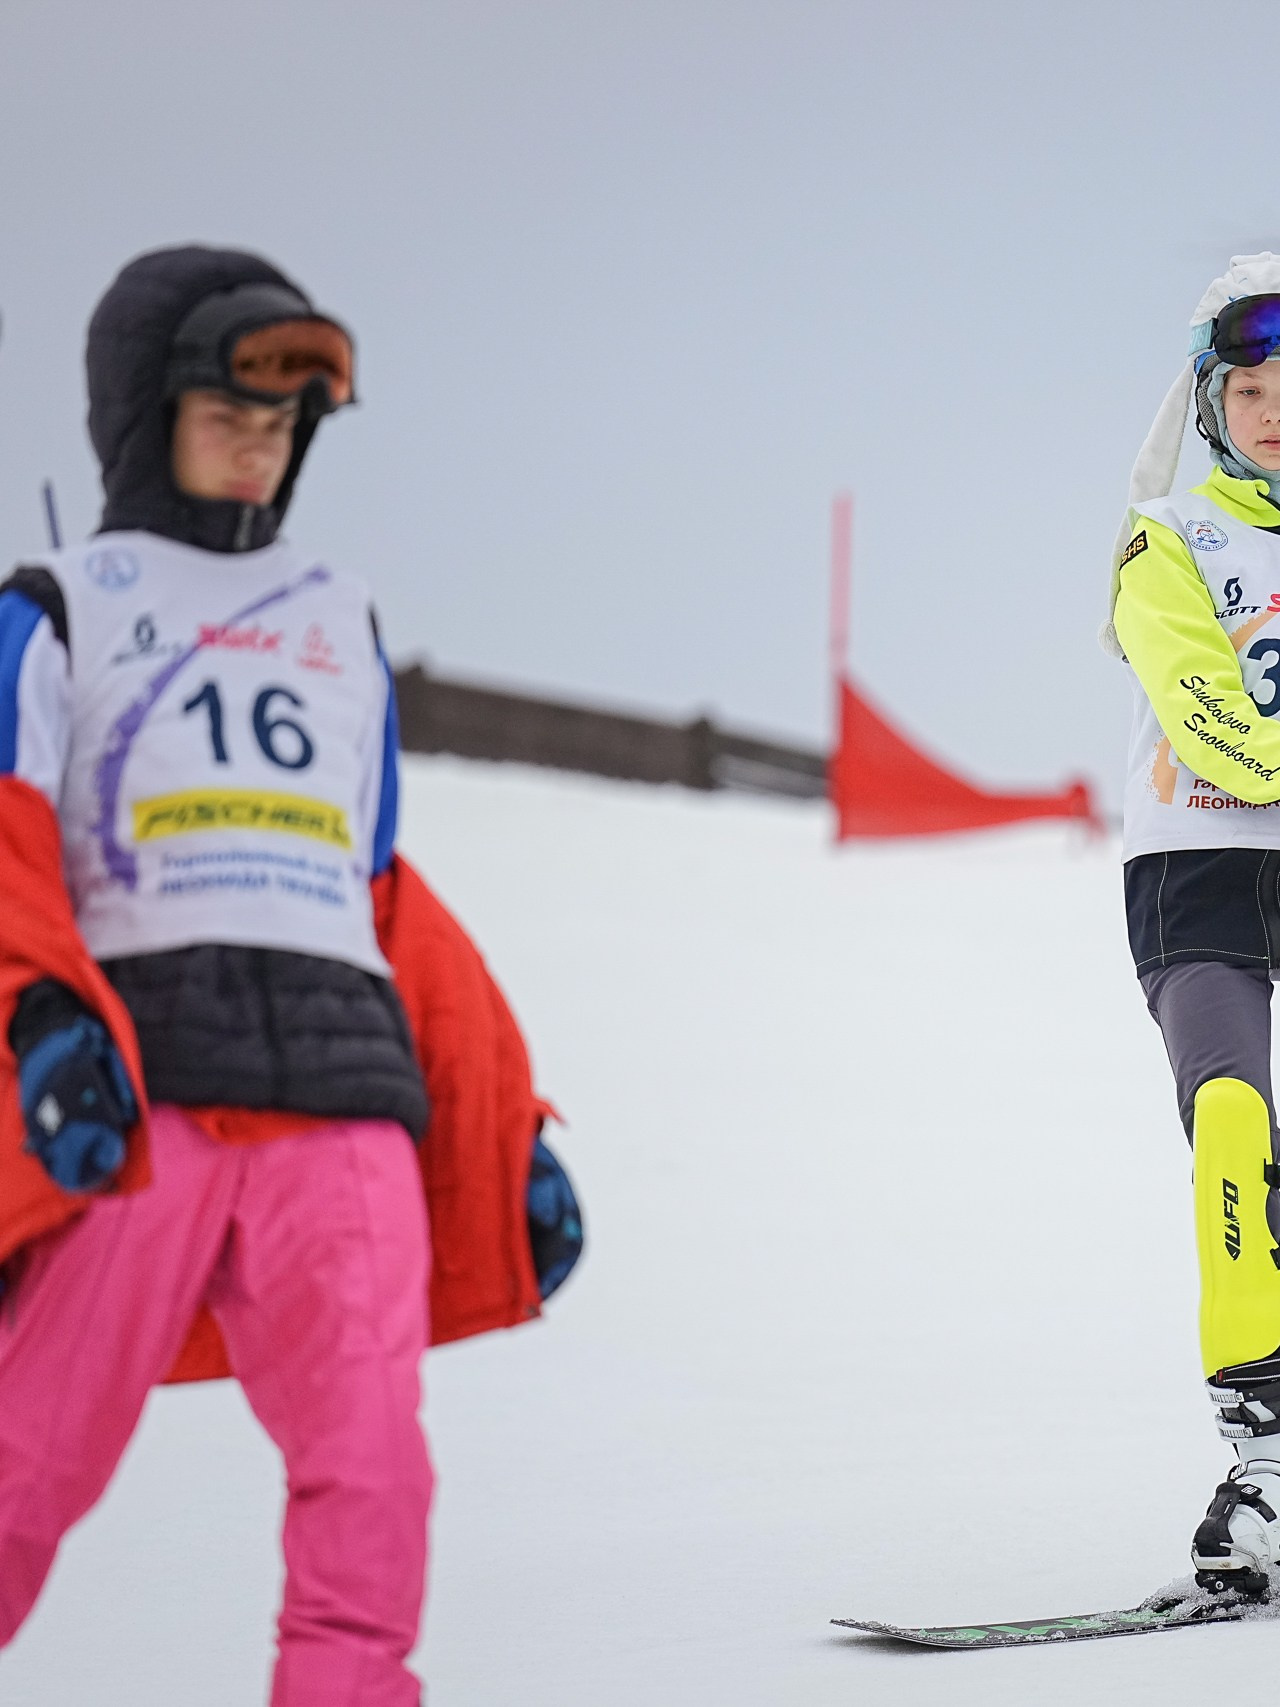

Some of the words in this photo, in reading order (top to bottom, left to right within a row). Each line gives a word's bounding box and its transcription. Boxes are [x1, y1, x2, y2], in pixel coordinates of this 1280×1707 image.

[1215, 605, 1261, 620] SCOTT
[182, 678, 315, 770] 16
[1222, 1177, 1241, 1248] UFO
